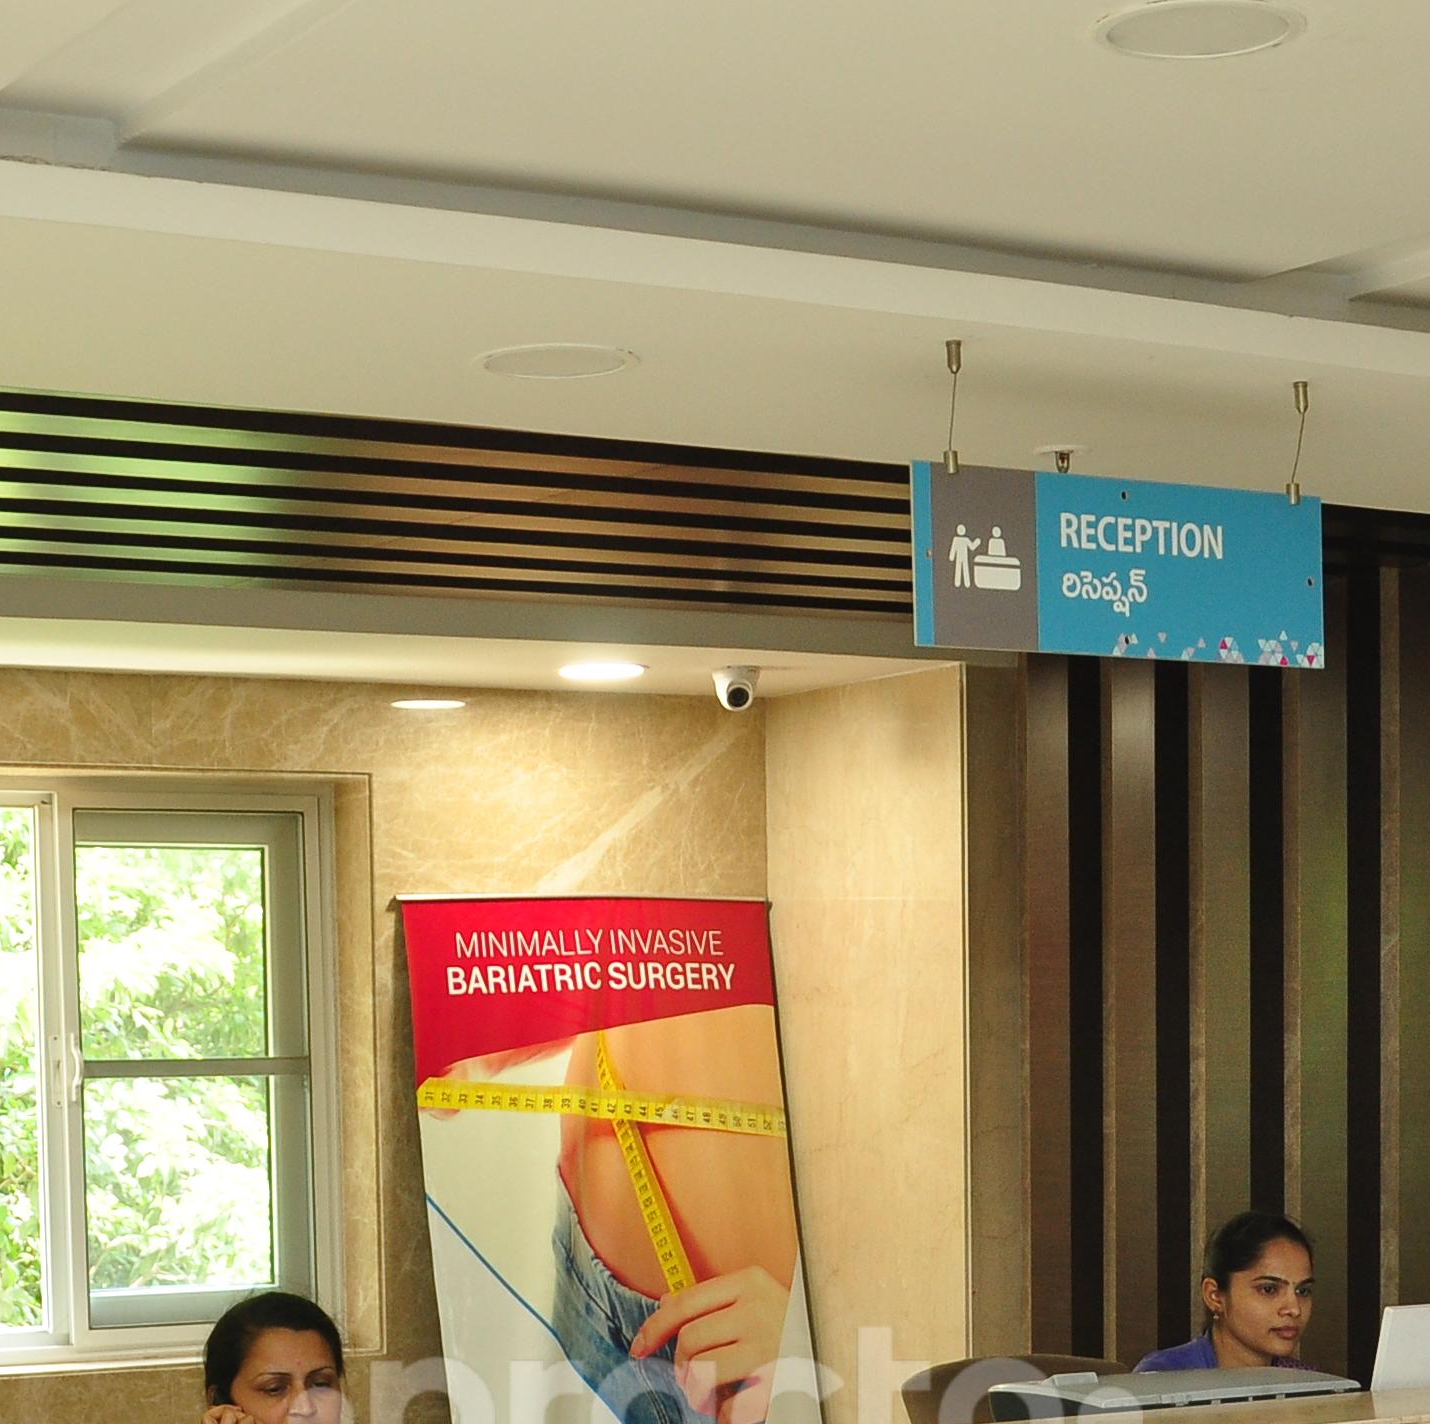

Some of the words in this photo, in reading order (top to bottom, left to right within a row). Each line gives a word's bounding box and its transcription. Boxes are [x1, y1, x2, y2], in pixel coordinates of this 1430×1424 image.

[1059, 511, 1224, 560] RECEPTION
[455, 928, 603, 958] MINIMALLY
[609, 929, 724, 956] INVASIVE
[446, 961, 602, 995] BARIATRIC
[607, 961, 735, 991] SURGERY
